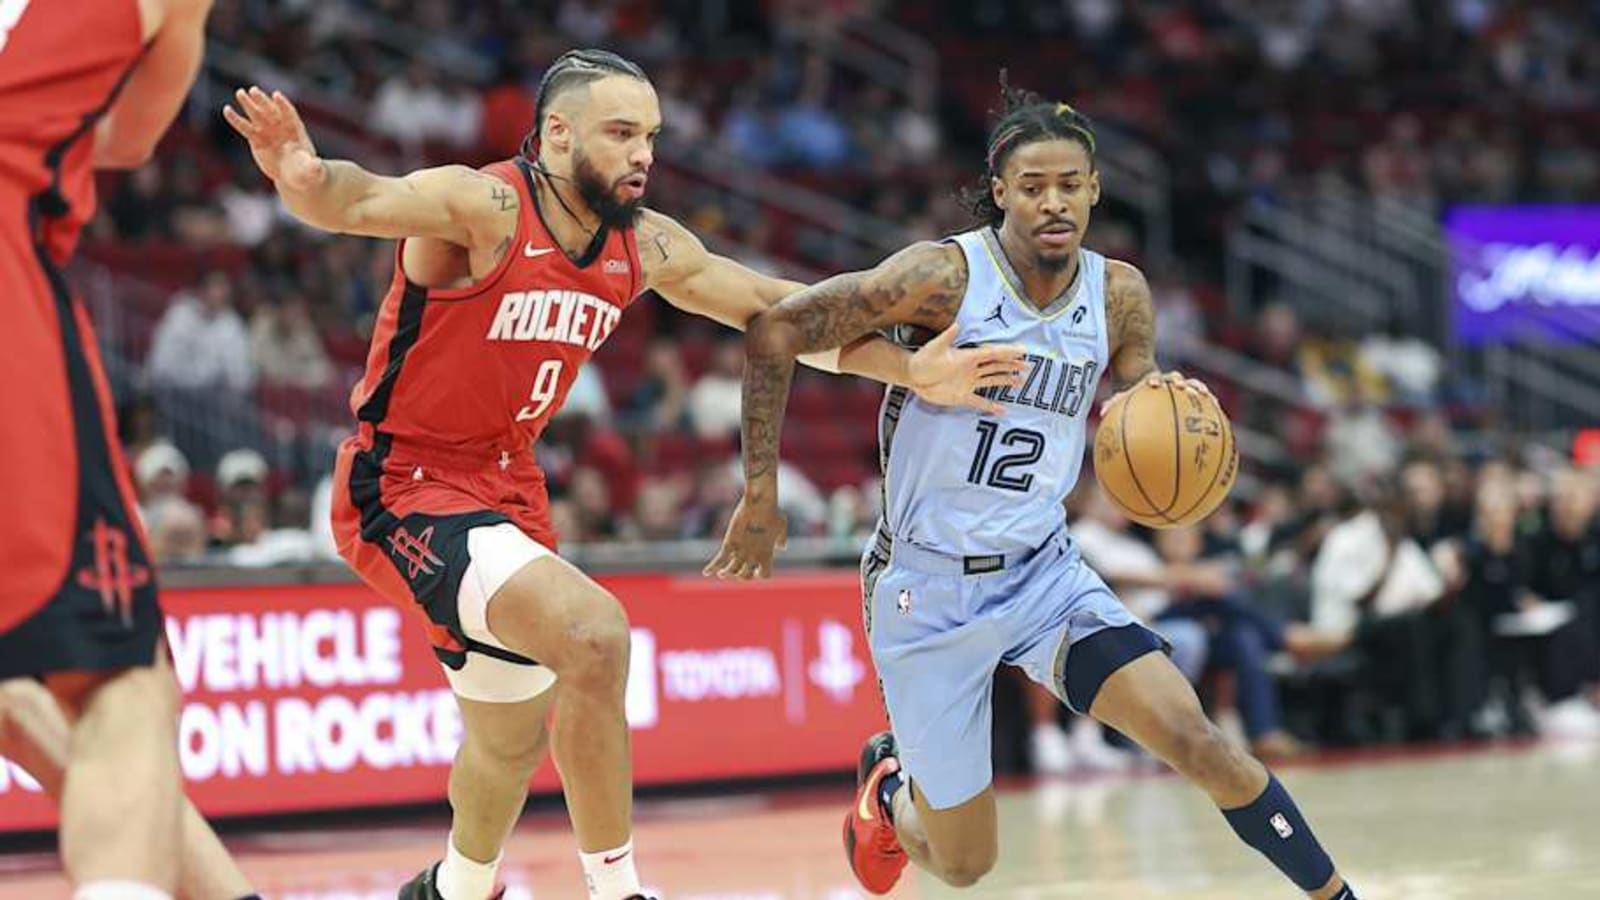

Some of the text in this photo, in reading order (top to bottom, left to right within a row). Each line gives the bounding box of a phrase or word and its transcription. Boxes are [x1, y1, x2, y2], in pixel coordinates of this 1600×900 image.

[486, 290, 622, 352] ROCKETS
[515, 360, 563, 422] 9
[967, 420, 1046, 492] 12
[165, 607, 402, 692] VEHICLE
[178, 701, 268, 781] ON
